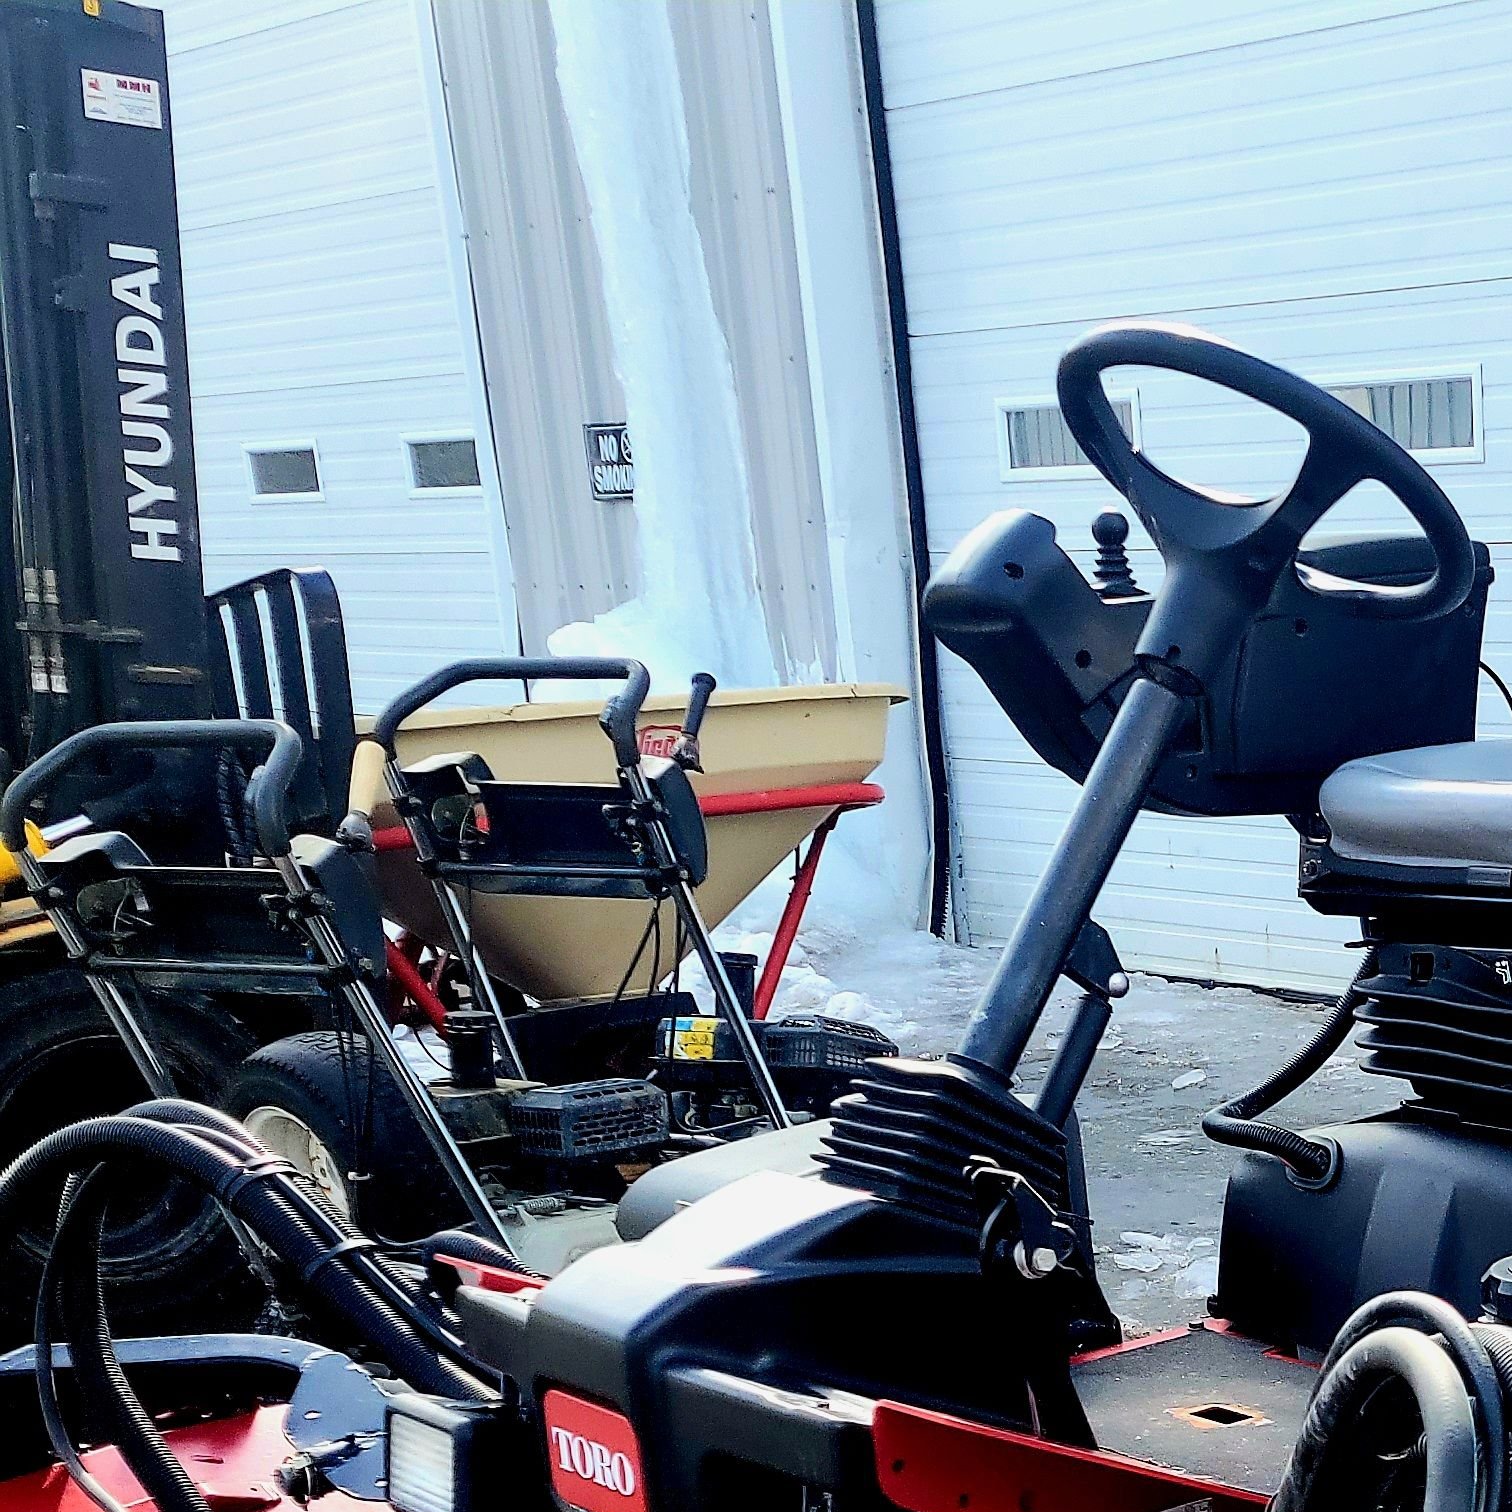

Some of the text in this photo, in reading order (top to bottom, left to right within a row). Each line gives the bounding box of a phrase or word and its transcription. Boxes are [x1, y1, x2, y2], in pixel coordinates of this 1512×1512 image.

[108, 243, 182, 562] HYUNDAI
[597, 434, 619, 462] NO
[551, 1426, 636, 1497] TORO
